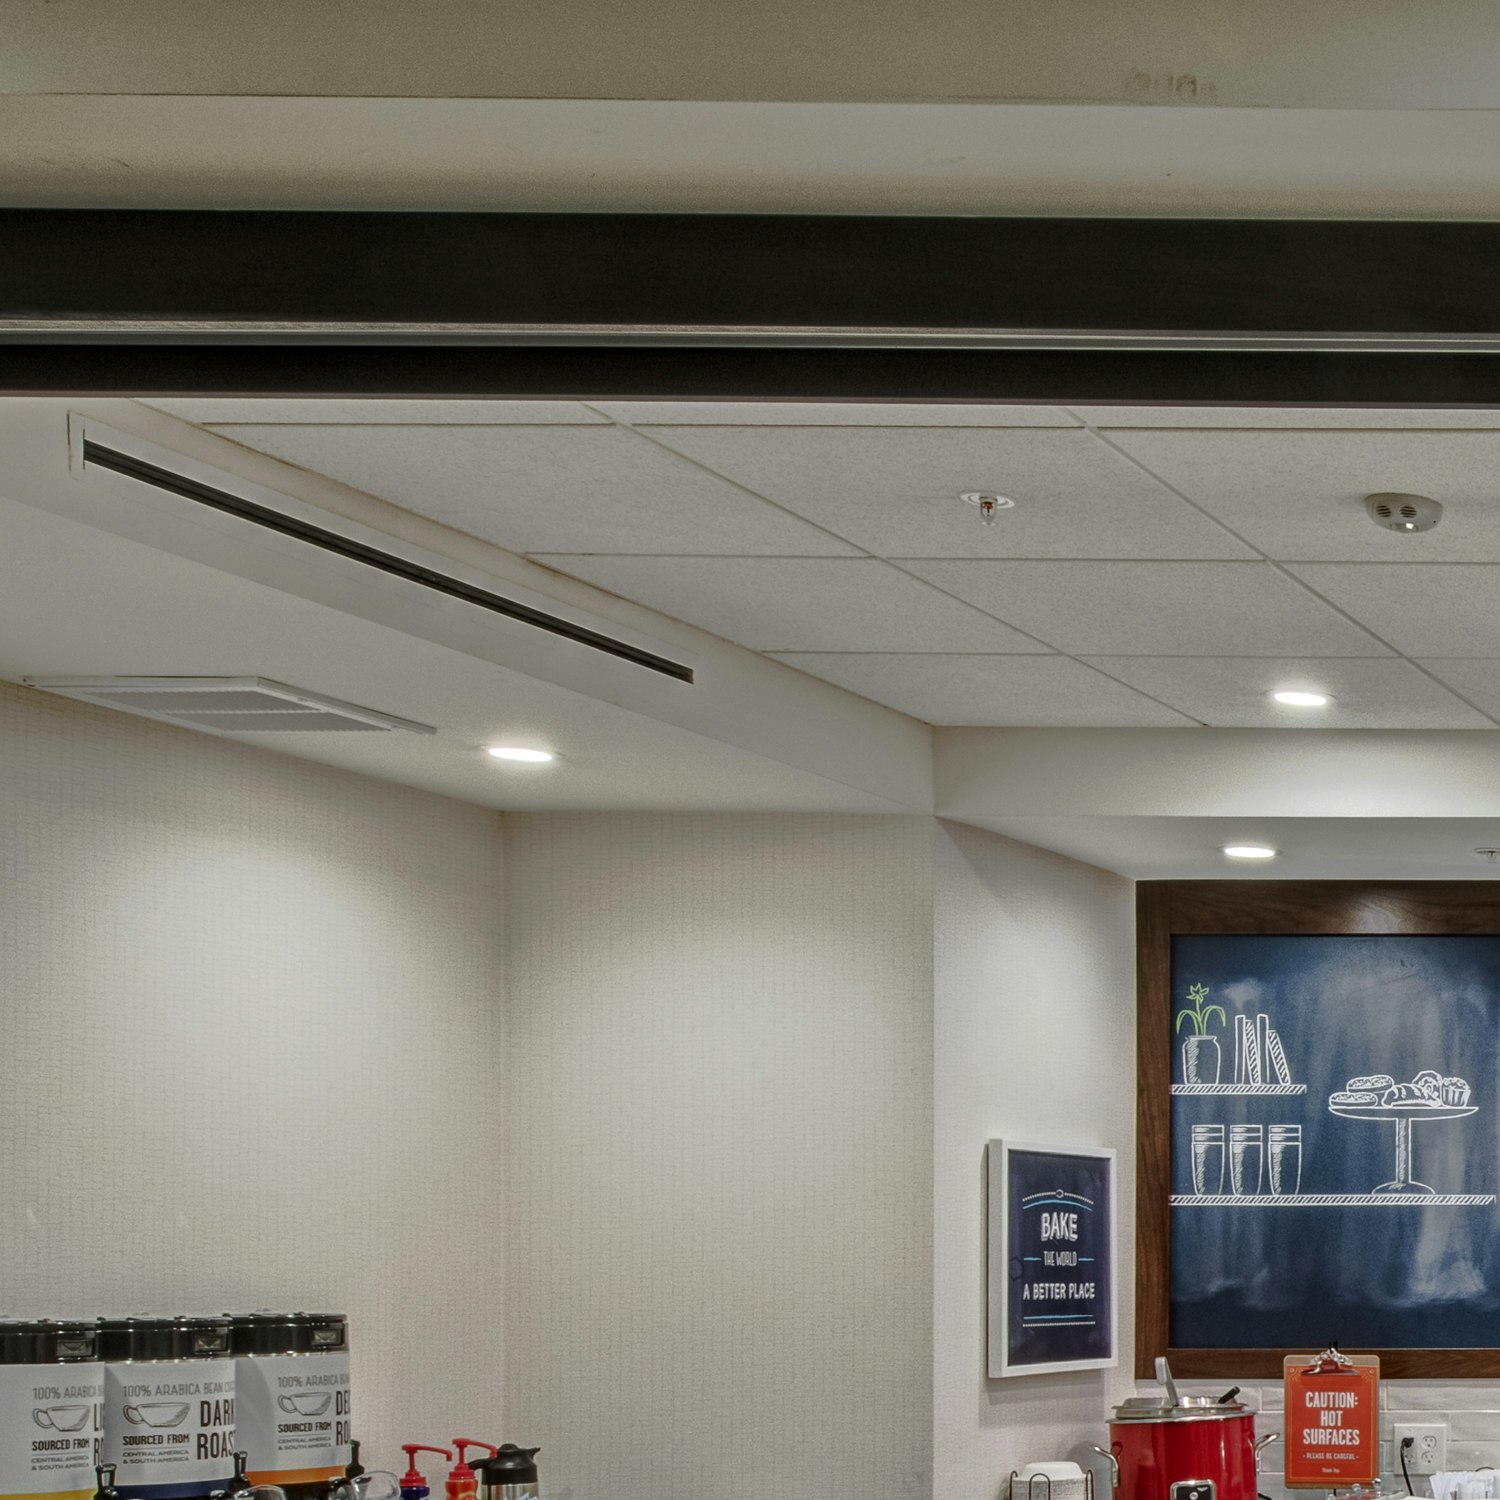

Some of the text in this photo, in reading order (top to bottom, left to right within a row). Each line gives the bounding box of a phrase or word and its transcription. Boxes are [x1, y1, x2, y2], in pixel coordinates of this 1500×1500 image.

[1041, 1212, 1078, 1241] BAKE
[1043, 1251, 1077, 1266] THE WORLD
[1023, 1283, 1095, 1300] A BETTER PLACE
[278, 1376, 303, 1388] 100%
[305, 1374, 338, 1386] ARABICA
[33, 1386, 61, 1400] 100%
[123, 1385, 152, 1397] 100%
[155, 1383, 201, 1396] ARABICA
[203, 1382, 224, 1395] BEAN
[1305, 1391, 1358, 1408] CAUTION:
[1320, 1410, 1343, 1426] HOT
[278, 1421, 332, 1433] SOURCED FROM
[32, 1438, 90, 1451] SOURCED FROM
[123, 1433, 190, 1446] SOURCED FROM
[1303, 1429, 1360, 1445] SURFACES
[1306, 1452, 1325, 1460] PLEASE
